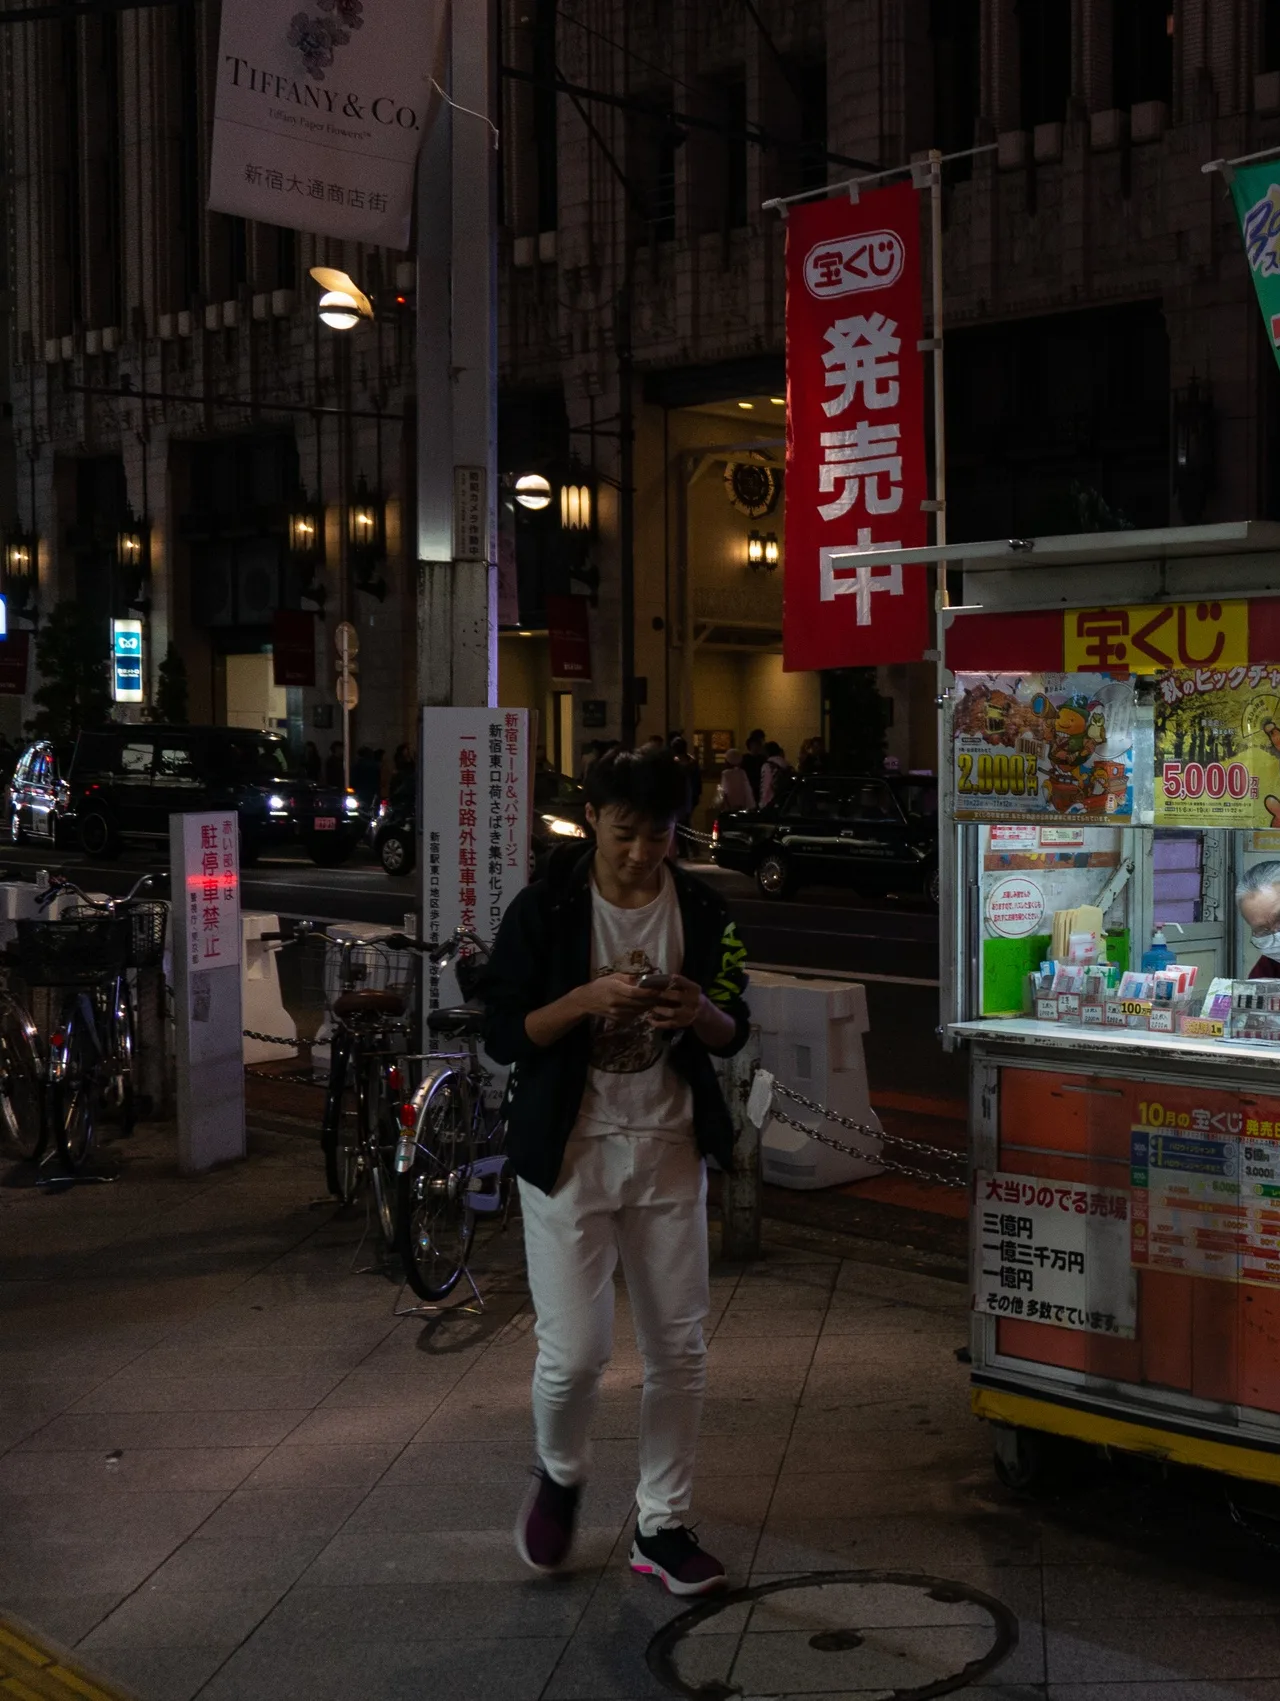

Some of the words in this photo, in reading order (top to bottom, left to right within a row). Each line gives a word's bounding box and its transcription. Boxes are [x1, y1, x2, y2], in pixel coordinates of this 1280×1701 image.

[225, 55, 338, 113] TIFFANY
[342, 93, 367, 119] &
[371, 96, 420, 131] CO.
[269, 107, 297, 125] Tiffany
[300, 116, 324, 132] Paper
[244, 163, 388, 213] 新宿大通商店街
[812, 240, 896, 289] 宝くじ
[818, 311, 904, 627] 発売中
[1076, 602, 1226, 672] 宝くじ
[504, 713, 519, 867] 新宿モール&パサージュ
[222, 820, 234, 901] 赤い部分は
[201, 824, 221, 958] 駐停車禁止
[986, 1178, 1128, 1221] 大当りのでる売場
[983, 1212, 1033, 1239] 三億円
[982, 1240, 1085, 1274] 一億三千万円
[982, 1265, 1033, 1292] 一億円
[986, 1293, 1023, 1315] その他
[1026, 1299, 1119, 1333] 多数でています。
